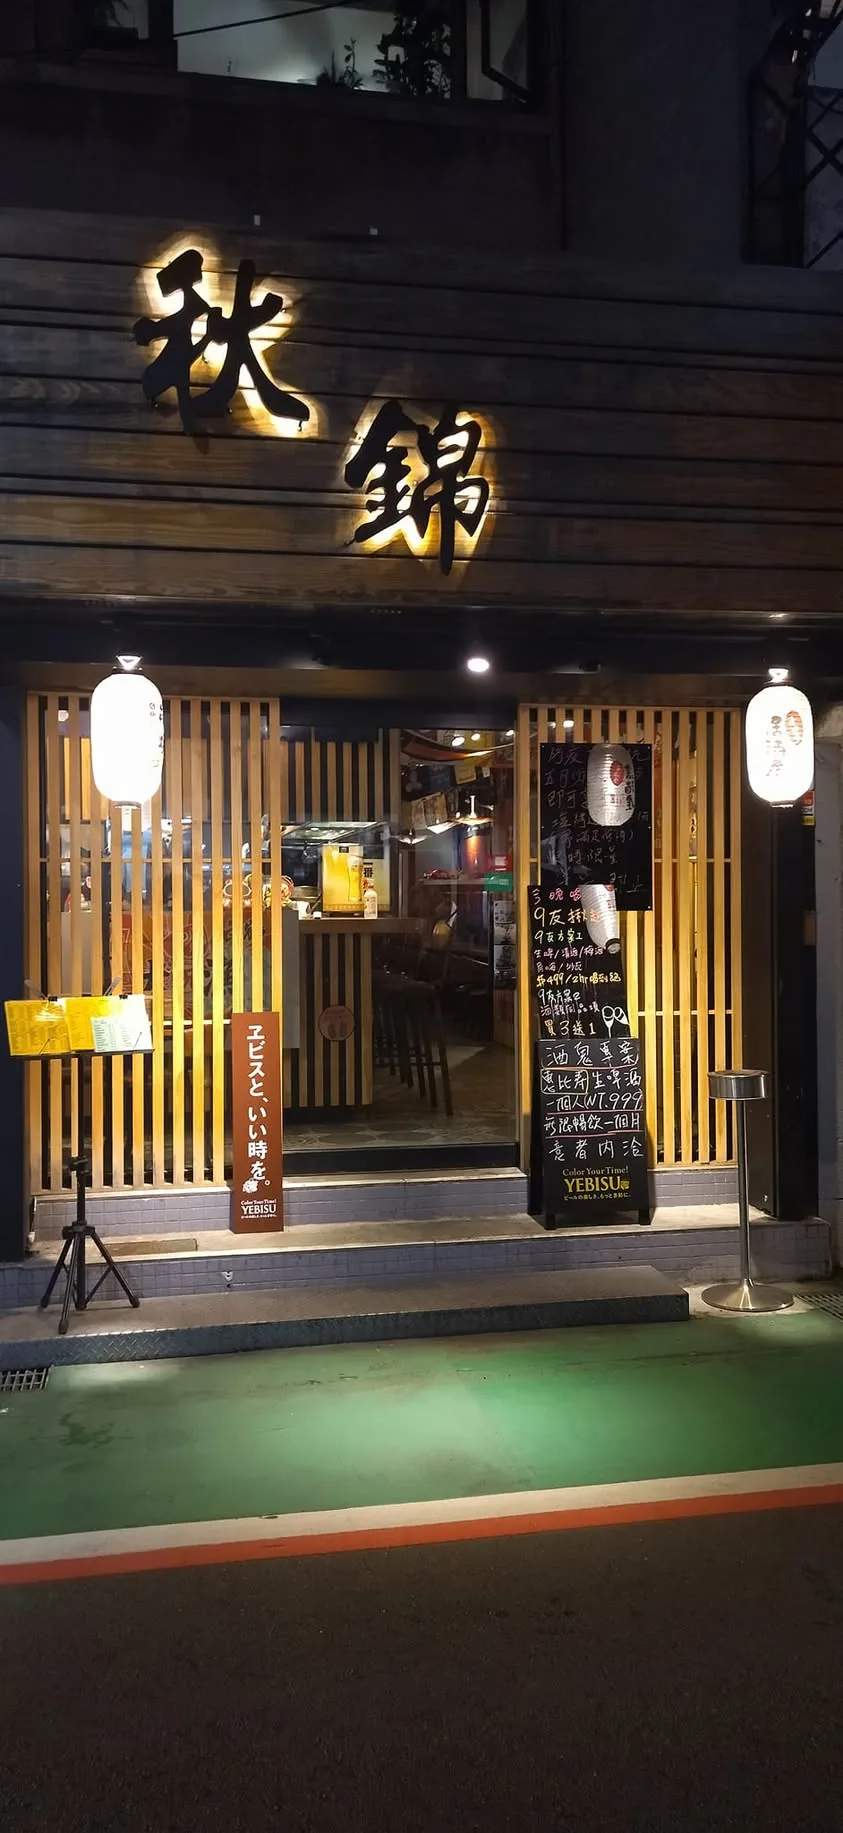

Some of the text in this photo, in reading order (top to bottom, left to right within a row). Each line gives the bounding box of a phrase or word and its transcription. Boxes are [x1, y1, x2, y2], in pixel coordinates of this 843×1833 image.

[562, 1165, 629, 1177] Color Your Time!
[564, 1176, 620, 1193] YEBISU
[241, 1204, 277, 1214] YEBISU
